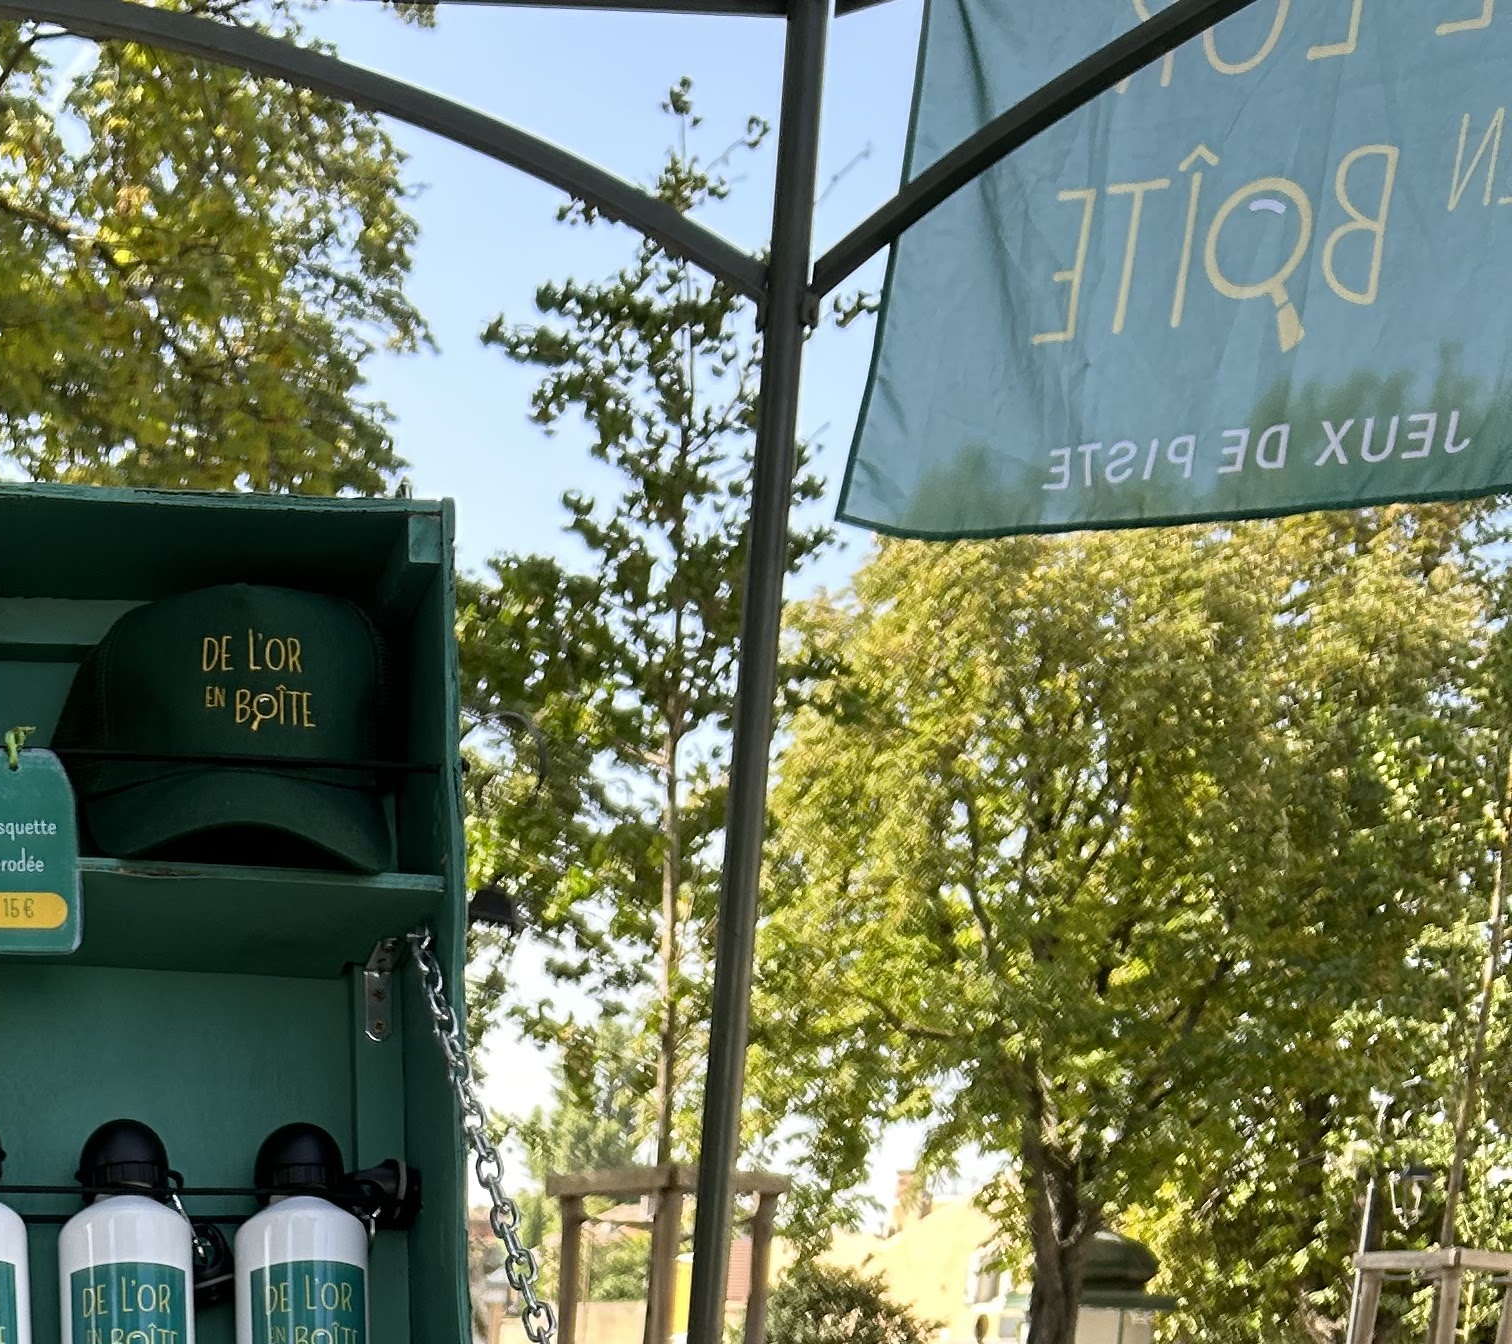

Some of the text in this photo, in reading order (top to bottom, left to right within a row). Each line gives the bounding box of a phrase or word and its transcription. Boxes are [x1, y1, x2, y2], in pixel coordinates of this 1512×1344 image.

[202, 628, 302, 673] DE L'OR
[206, 684, 316, 731] EN BOÎTE
[82, 1276, 171, 1318] DE L'OR
[265, 1274, 352, 1316] DE L'OR
